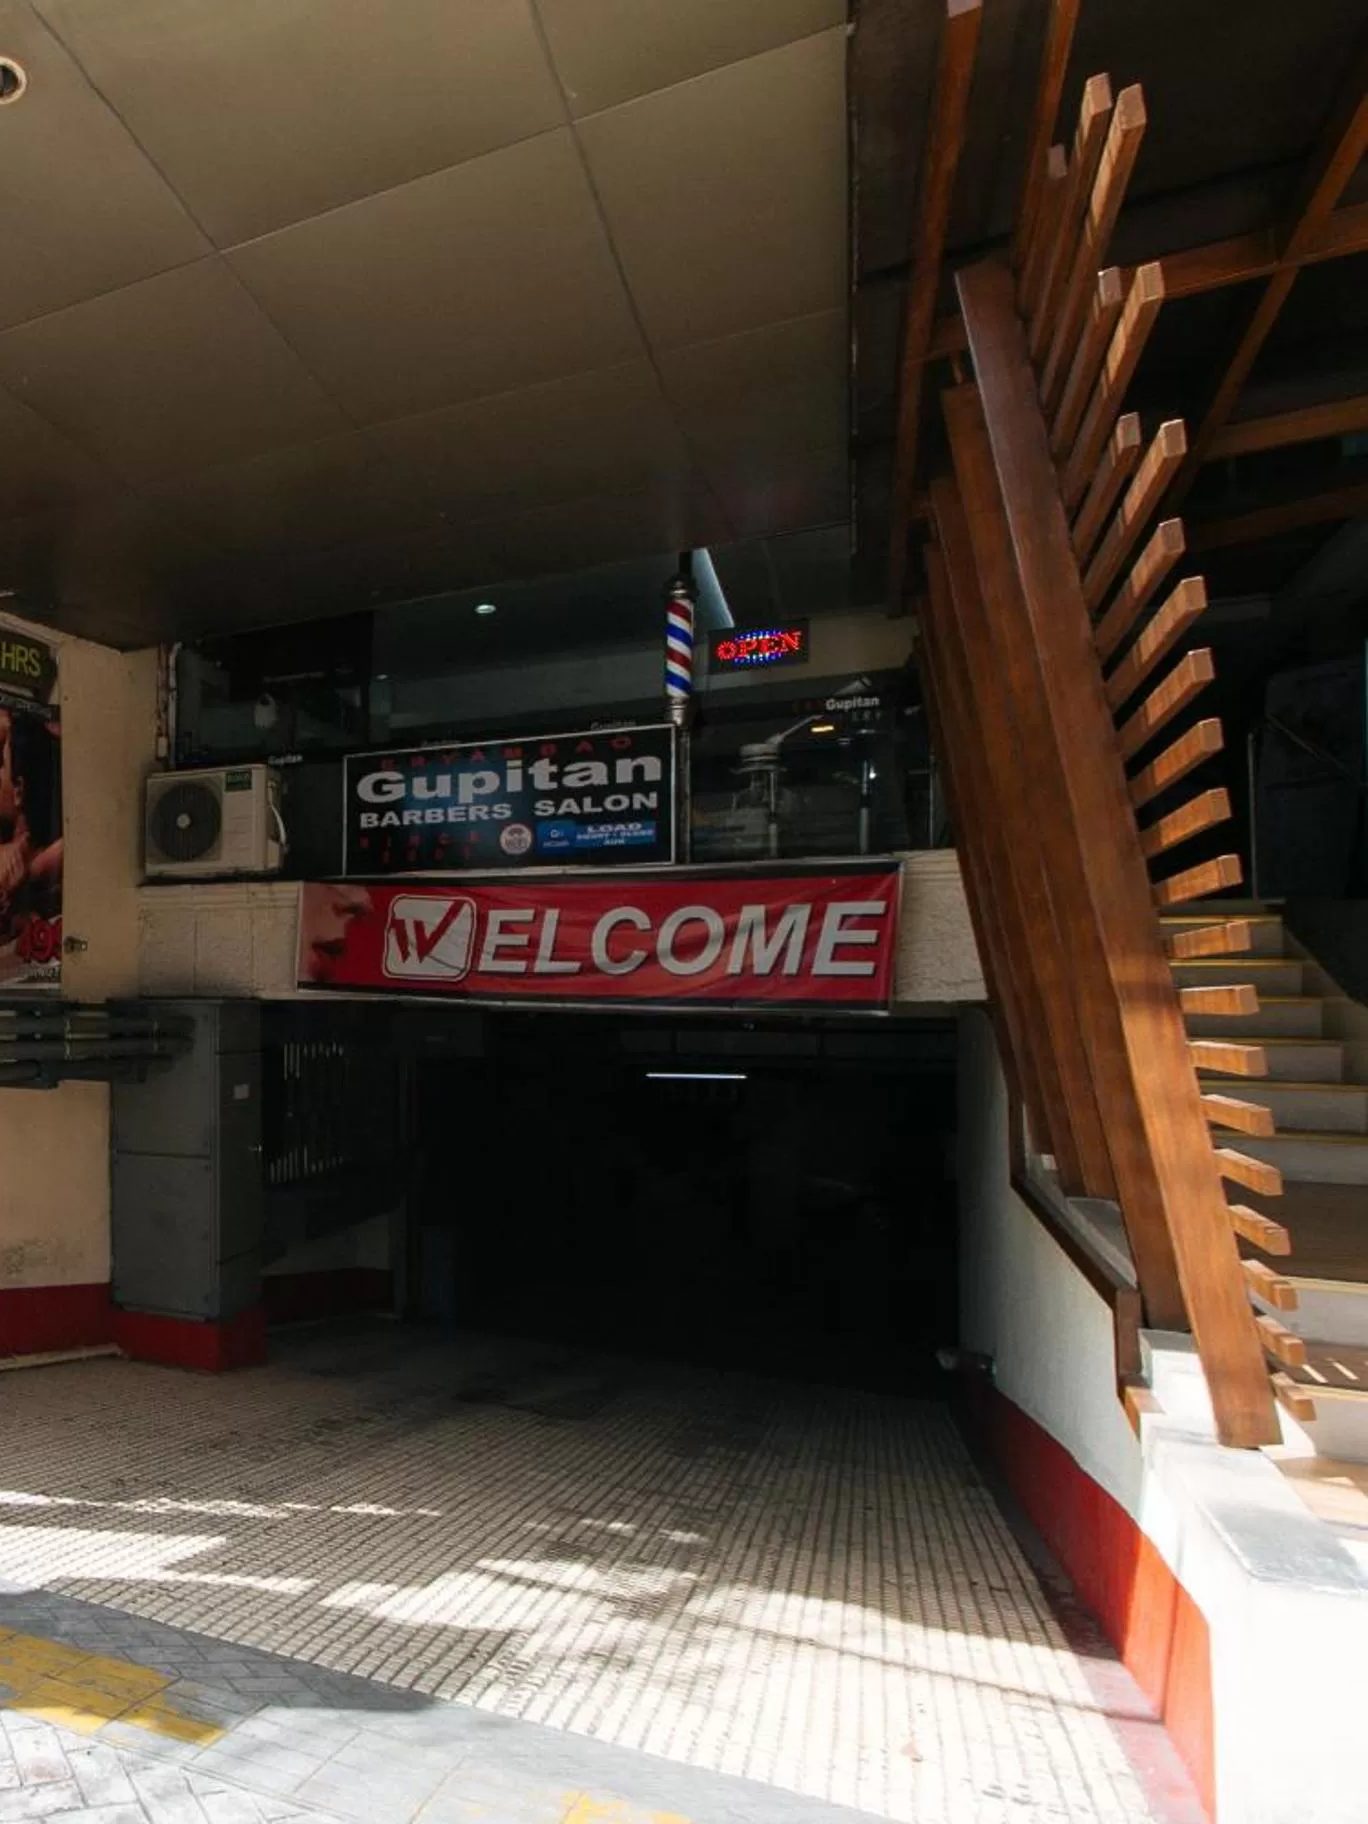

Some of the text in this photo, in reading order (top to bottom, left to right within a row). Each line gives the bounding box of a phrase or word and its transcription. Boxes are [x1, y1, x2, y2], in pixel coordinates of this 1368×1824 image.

[0, 641, 42, 679] HRS
[715, 630, 803, 661] OPEN
[356, 755, 663, 804] Gupitan
[359, 791, 659, 829] BARBERS SALON
[390, 898, 887, 977] WELCOME
